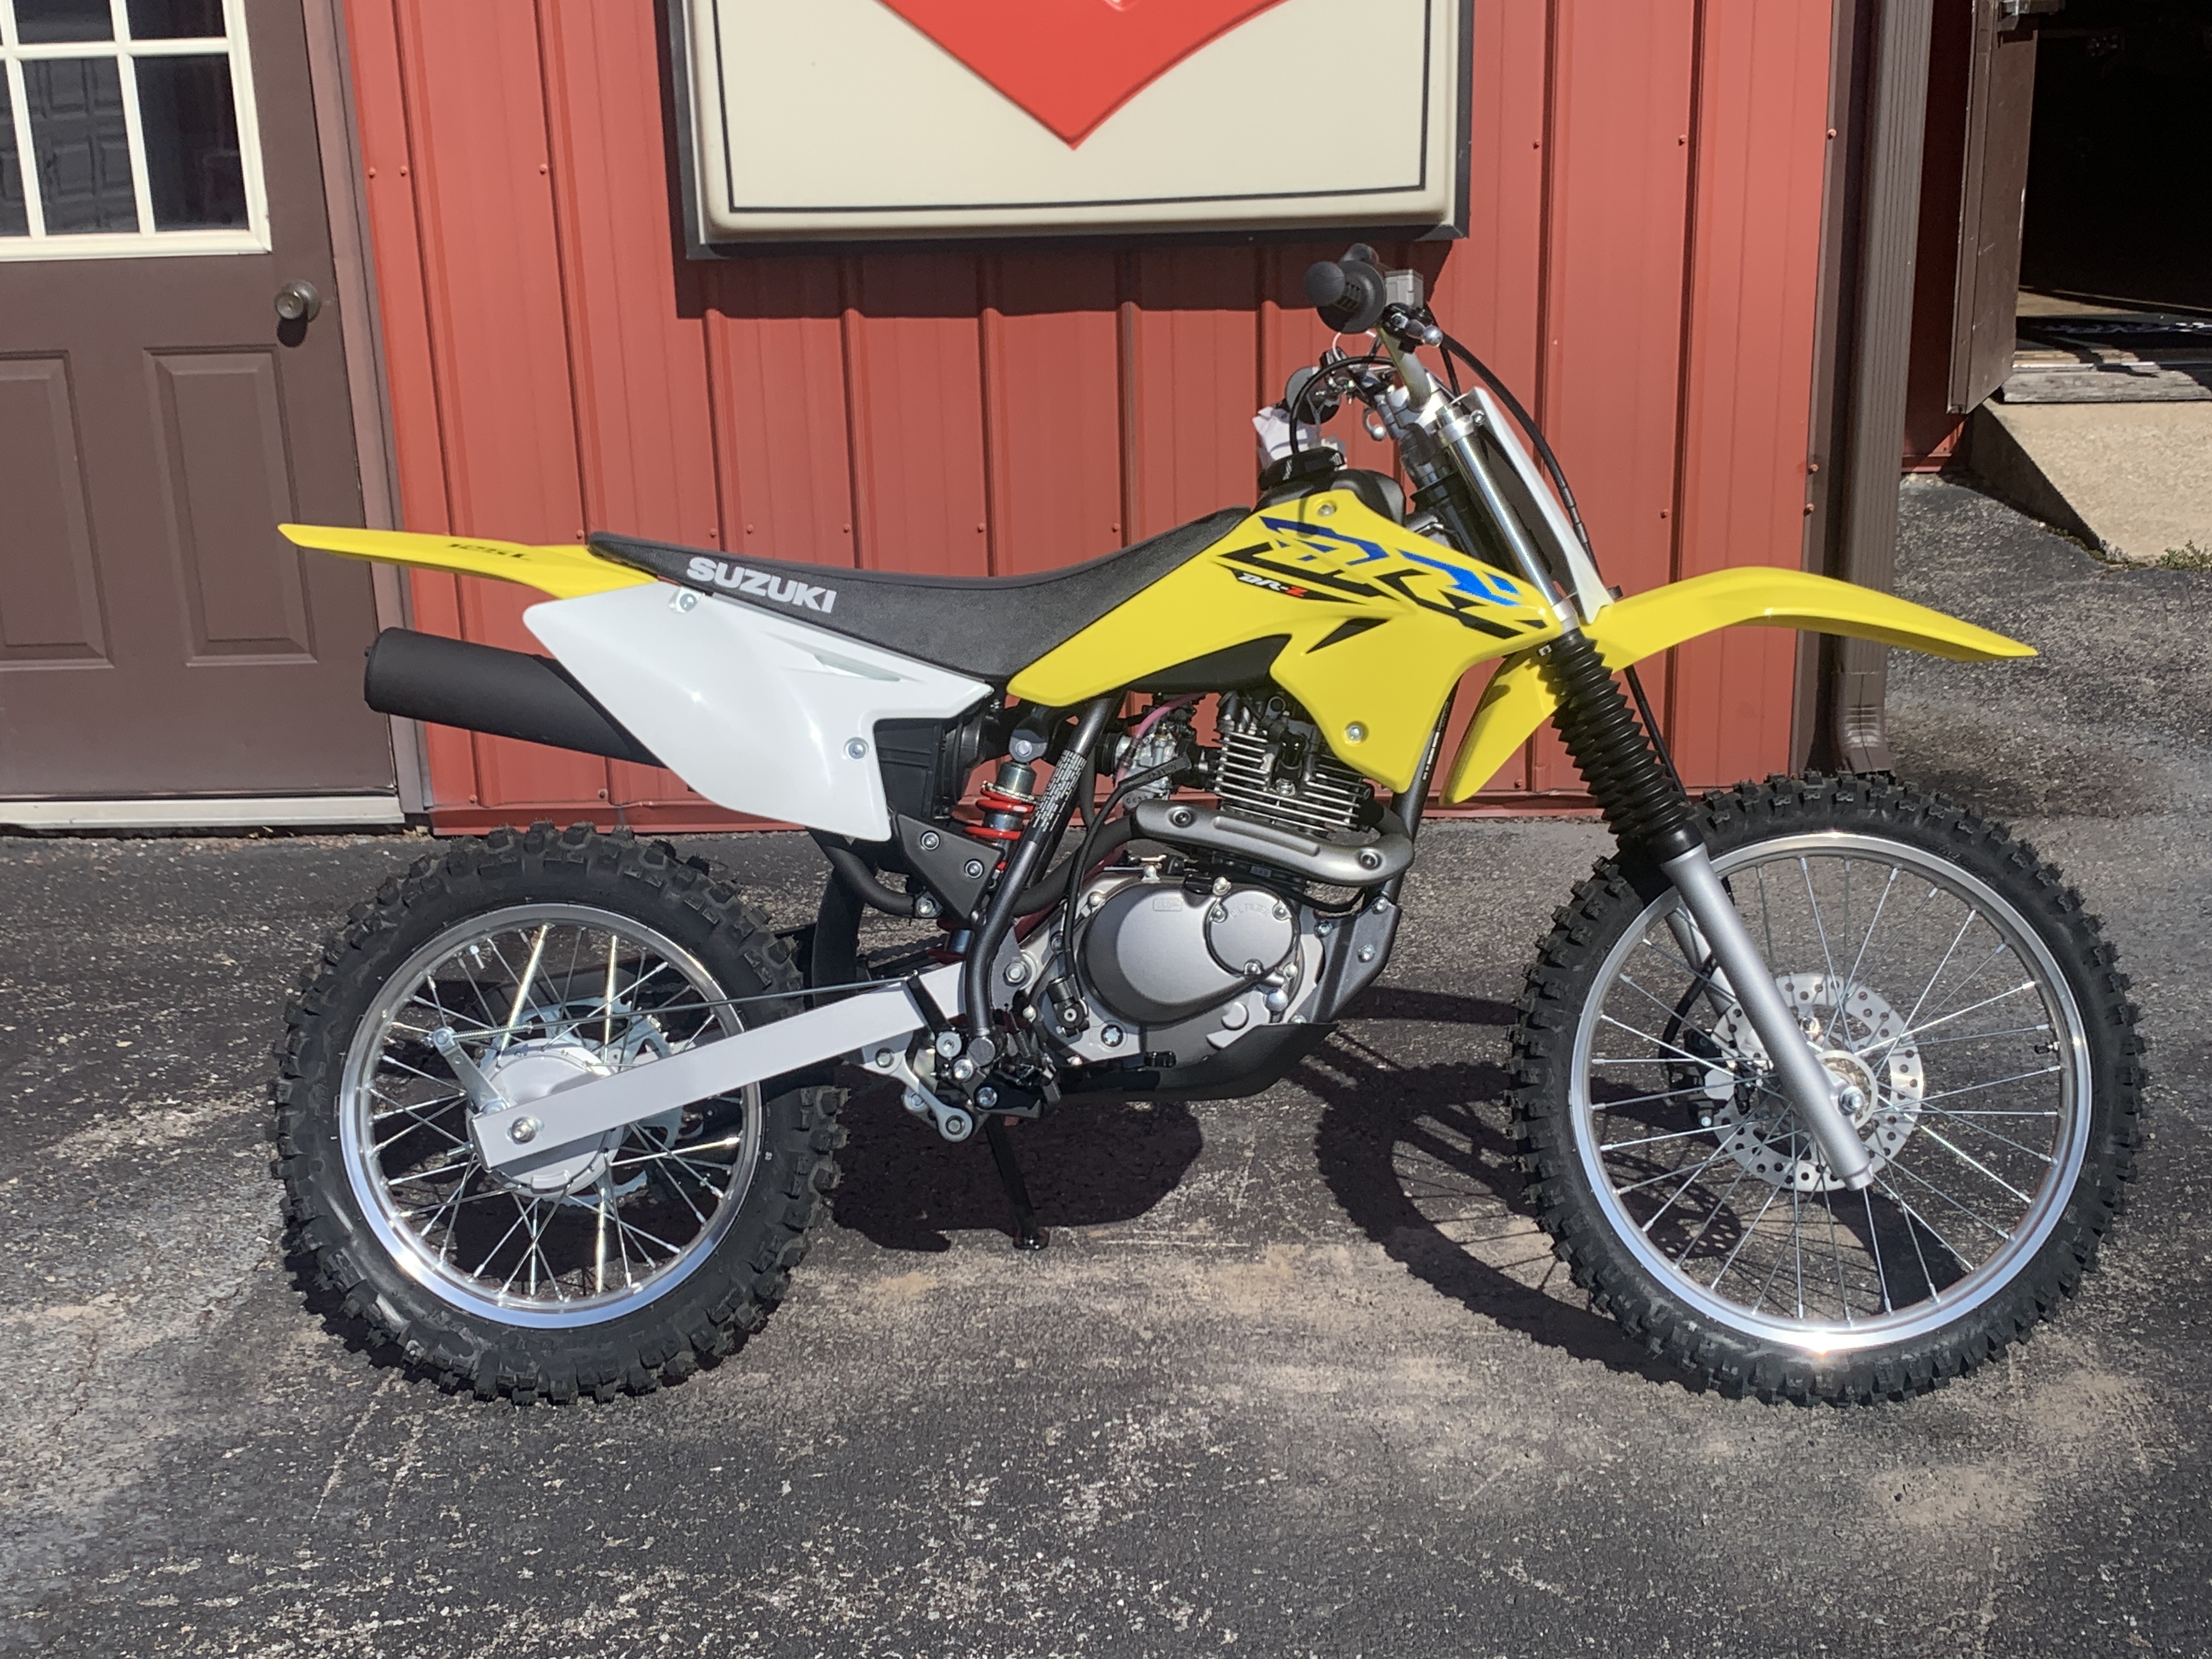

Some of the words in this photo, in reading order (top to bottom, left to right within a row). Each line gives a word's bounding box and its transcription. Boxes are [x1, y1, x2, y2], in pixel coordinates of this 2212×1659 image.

[686, 556, 837, 613] SUZUKI
[1237, 572, 1308, 597] DR-Z
[1230, 906, 1244, 918] OIL
[1244, 902, 1271, 918] FILTER
